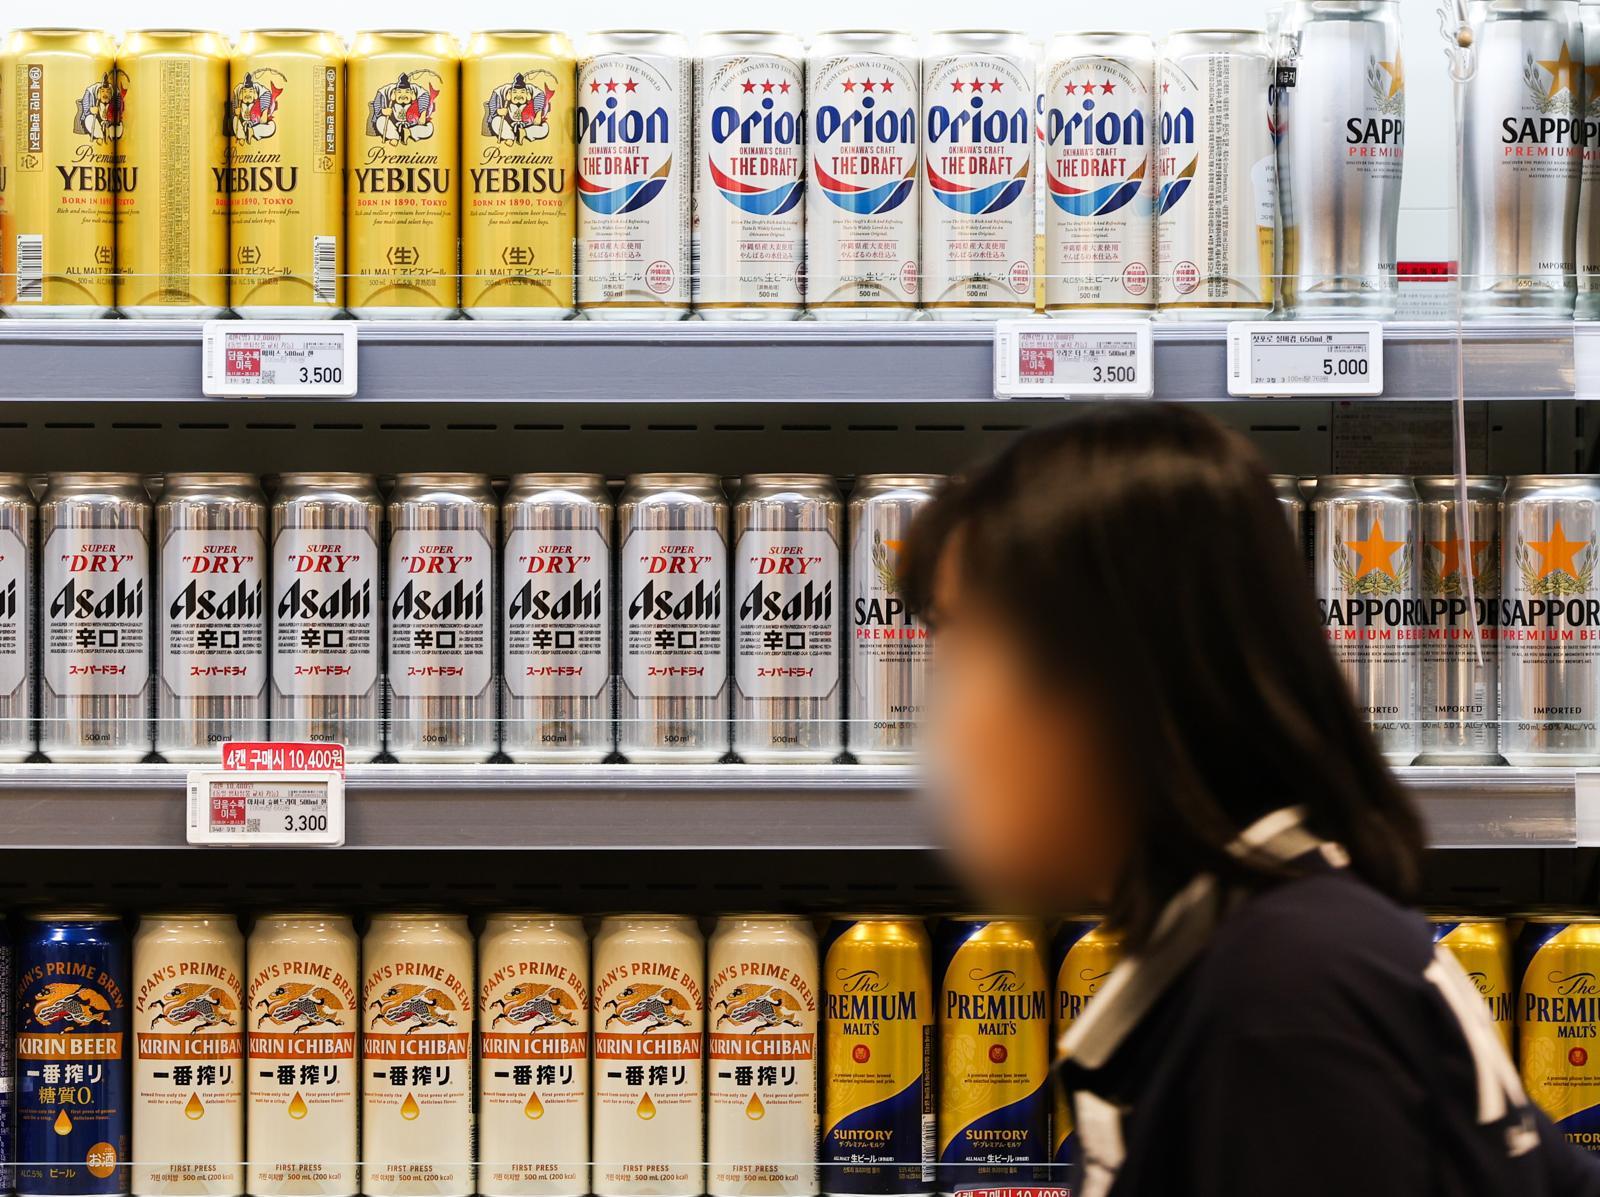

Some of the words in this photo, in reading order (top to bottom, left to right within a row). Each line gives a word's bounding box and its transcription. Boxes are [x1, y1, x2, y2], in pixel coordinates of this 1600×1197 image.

[30, 92, 40, 111] 미만
[816, 97, 916, 144] Orion
[928, 96, 1028, 144] Orion
[1047, 99, 1144, 146] Orion
[30, 113, 41, 150] 판매금지
[1346, 118, 1405, 144] SAPP
[1502, 118, 1584, 144] SAPPO
[364, 146, 438, 166] Premium
[480, 147, 554, 166] Premium
[840, 146, 874, 154] OKINAWA'S
[876, 146, 896, 154] CRAFT
[948, 146, 982, 154] OKINAWA'S
[984, 146, 1004, 154] CRAFT
[583, 157, 602, 175] THE
[604, 156, 649, 175] DRAFT
[730, 158, 757, 176] THE
[759, 158, 798, 176] DRAFT
[832, 156, 858, 175] THE
[861, 156, 903, 175] DRAFT
[941, 156, 966, 175] THE
[970, 156, 1013, 175] DRAFT
[1056, 158, 1078, 178] THE
[1081, 158, 1127, 178] DRAFT
[56, 166, 138, 194] YEBISU
[212, 166, 298, 194] YEBISU
[354, 168, 450, 194] YEBISU
[470, 168, 566, 194] YEBISU
[263, 197, 294, 205] TOKYO
[358, 199, 378, 207] BORN
[394, 198, 418, 208] 1890,
[421, 199, 448, 207] TOKYO
[300, 367, 342, 384] 3,500
[1092, 366, 1136, 383] 3,500
[1324, 359, 1368, 376] 5,000
[81, 544, 116, 552] SUPER
[419, 546, 453, 554] SUPER
[50, 578, 143, 620] Asahi
[170, 578, 262, 620] Asahi
[278, 578, 370, 619] Asahi
[392, 579, 483, 620] Asahi
[509, 579, 601, 620] Asahi
[629, 579, 720, 620] Asahi
[740, 580, 832, 621] Asahi
[1502, 598, 1600, 627] SAPPOR
[76, 628, 118, 647] 辛口
[301, 629, 343, 648] 辛口
[533, 630, 575, 649] 辛口
[764, 630, 805, 650] 辛口
[1504, 630, 1574, 640] PREMIUM
[69, 665, 126, 675] スーパードライ
[408, 667, 463, 676] スーパードライ
[1435, 706, 1482, 714] IMPORTED
[1534, 706, 1582, 714] IMPORTED
[227, 749, 246, 769] 4캔
[250, 749, 284, 770] 구매시
[288, 750, 344, 770] 10,400원
[284, 815, 327, 832] 3,300
[46, 962, 94, 979] PRIME
[98, 972, 124, 1009] BREW
[136, 967, 176, 1012] JAPAN'S
[180, 962, 225, 980] PRIME
[480, 964, 516, 1012] JAPAN'S
[519, 962, 568, 980] PRIME
[568, 975, 590, 1012] BREW
[836, 968, 889, 992] The
[969, 968, 1024, 992] The
[947, 990, 1046, 1021] PREMIUM
[843, 1021, 880, 1035] MALT'S
[978, 1021, 1016, 1035] MALT'S
[1558, 1024, 1597, 1038] MALT'S
[19, 1038, 65, 1054] KIRIN
[71, 1038, 117, 1054] BEER
[140, 1040, 180, 1054] KIRIN
[184, 1040, 243, 1054] ICHIBAN
[364, 1040, 397, 1054] KIRIN
[400, 1040, 466, 1055] ICHIBAN
[596, 1040, 633, 1054] KIRIN
[637, 1040, 699, 1055] ICHIBAN
[27, 1064, 102, 1084] 一番搾り
[260, 1065, 338, 1085] 一番搾り
[719, 1066, 796, 1086] 一番搾り
[834, 1129, 892, 1140] SUNTORY
[965, 1129, 1028, 1140] SUNTORY
[89, 1154, 114, 1167] お酒
[170, 1164, 192, 1172] FIRST
[195, 1164, 217, 1172] PRESS
[987, 1154, 1014, 1163] 生ビール
[50, 1168, 75, 1178] ビール
[288, 1173, 300, 1181] 500
[302, 1173, 312, 1181] mL
[313, 1173, 327, 1182] (200
